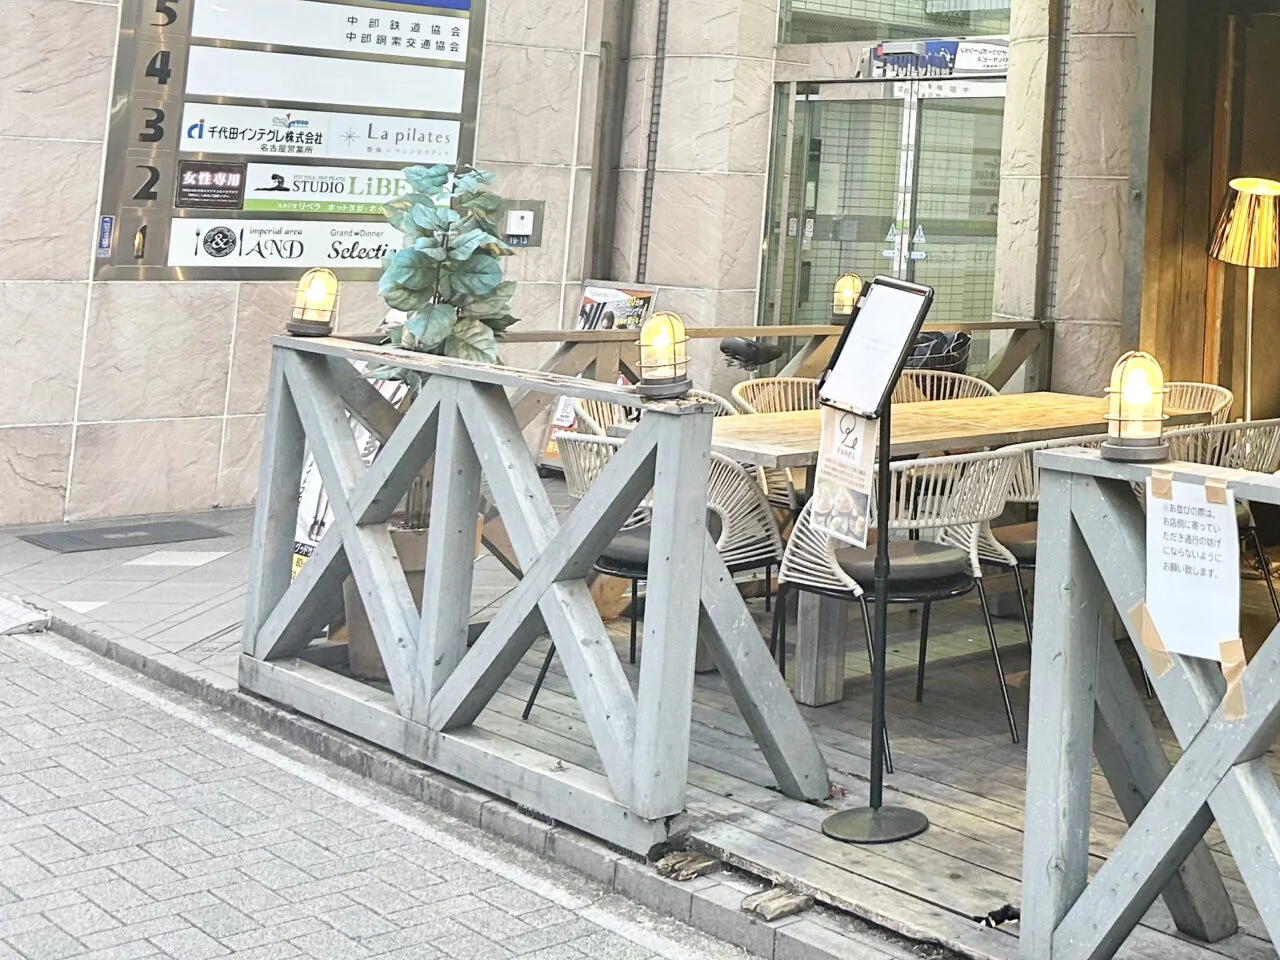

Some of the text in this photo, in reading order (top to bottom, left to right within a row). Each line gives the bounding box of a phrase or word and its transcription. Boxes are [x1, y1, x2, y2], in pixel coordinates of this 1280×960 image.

[144, 50, 172, 85] 4
[138, 107, 166, 143] 3
[207, 125, 323, 145] 千代田インテグレ株式会社
[367, 122, 451, 146] La pilates
[260, 143, 313, 155] 名古屋営業所
[132, 164, 161, 201] 2
[182, 170, 241, 188] 女性専用
[292, 175, 408, 197] STUDIO LiBE
[249, 226, 284, 236] imperial
[330, 228, 353, 238] Grand
[133, 224, 148, 260] 1
[245, 239, 305, 260] AND
[1162, 516, 1222, 534] お店側に寄ってい
[1162, 545, 1223, 563] にならないように
[1162, 561, 1219, 579] お願い致します。
